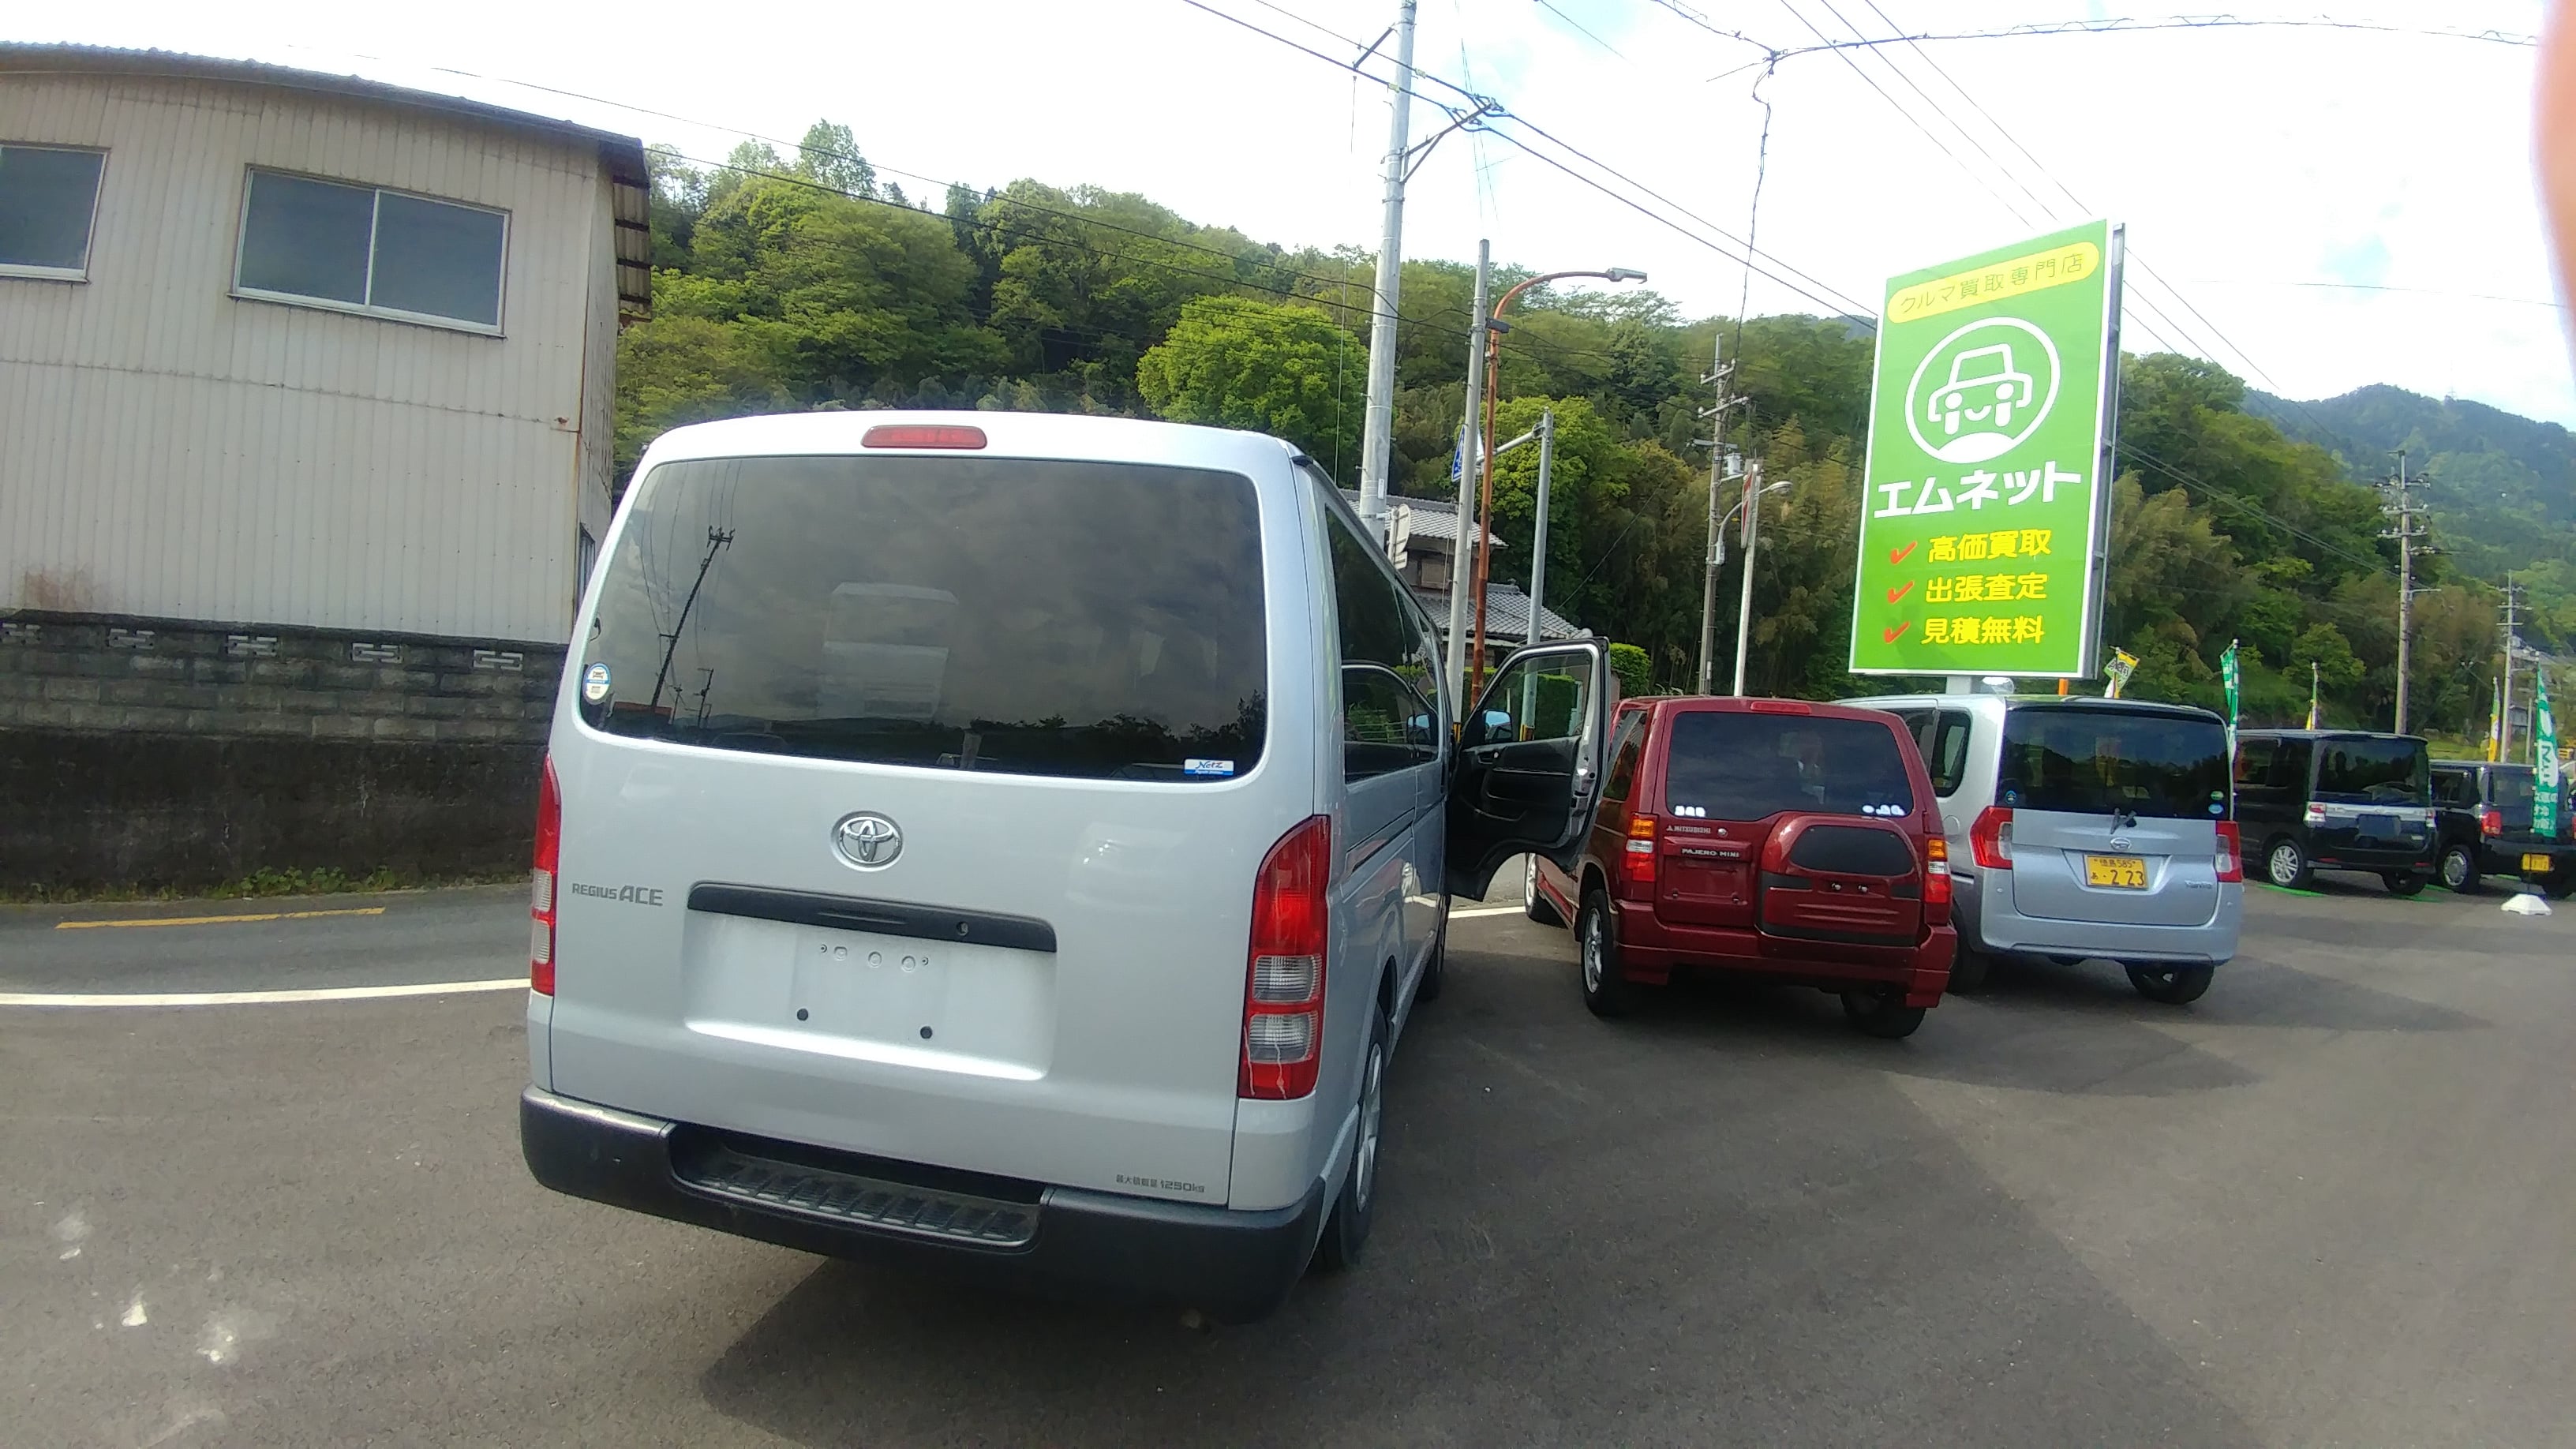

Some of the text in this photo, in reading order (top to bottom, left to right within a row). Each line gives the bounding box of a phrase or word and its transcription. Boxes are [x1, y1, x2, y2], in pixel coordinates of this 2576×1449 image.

[1900, 253, 2083, 313] クルマ買取専門店
[1874, 460, 2081, 519] エムネット
[1928, 530, 2052, 563] 高価買取
[1925, 572, 2048, 603] 出張査定
[1921, 615, 2045, 645] 見積無料
